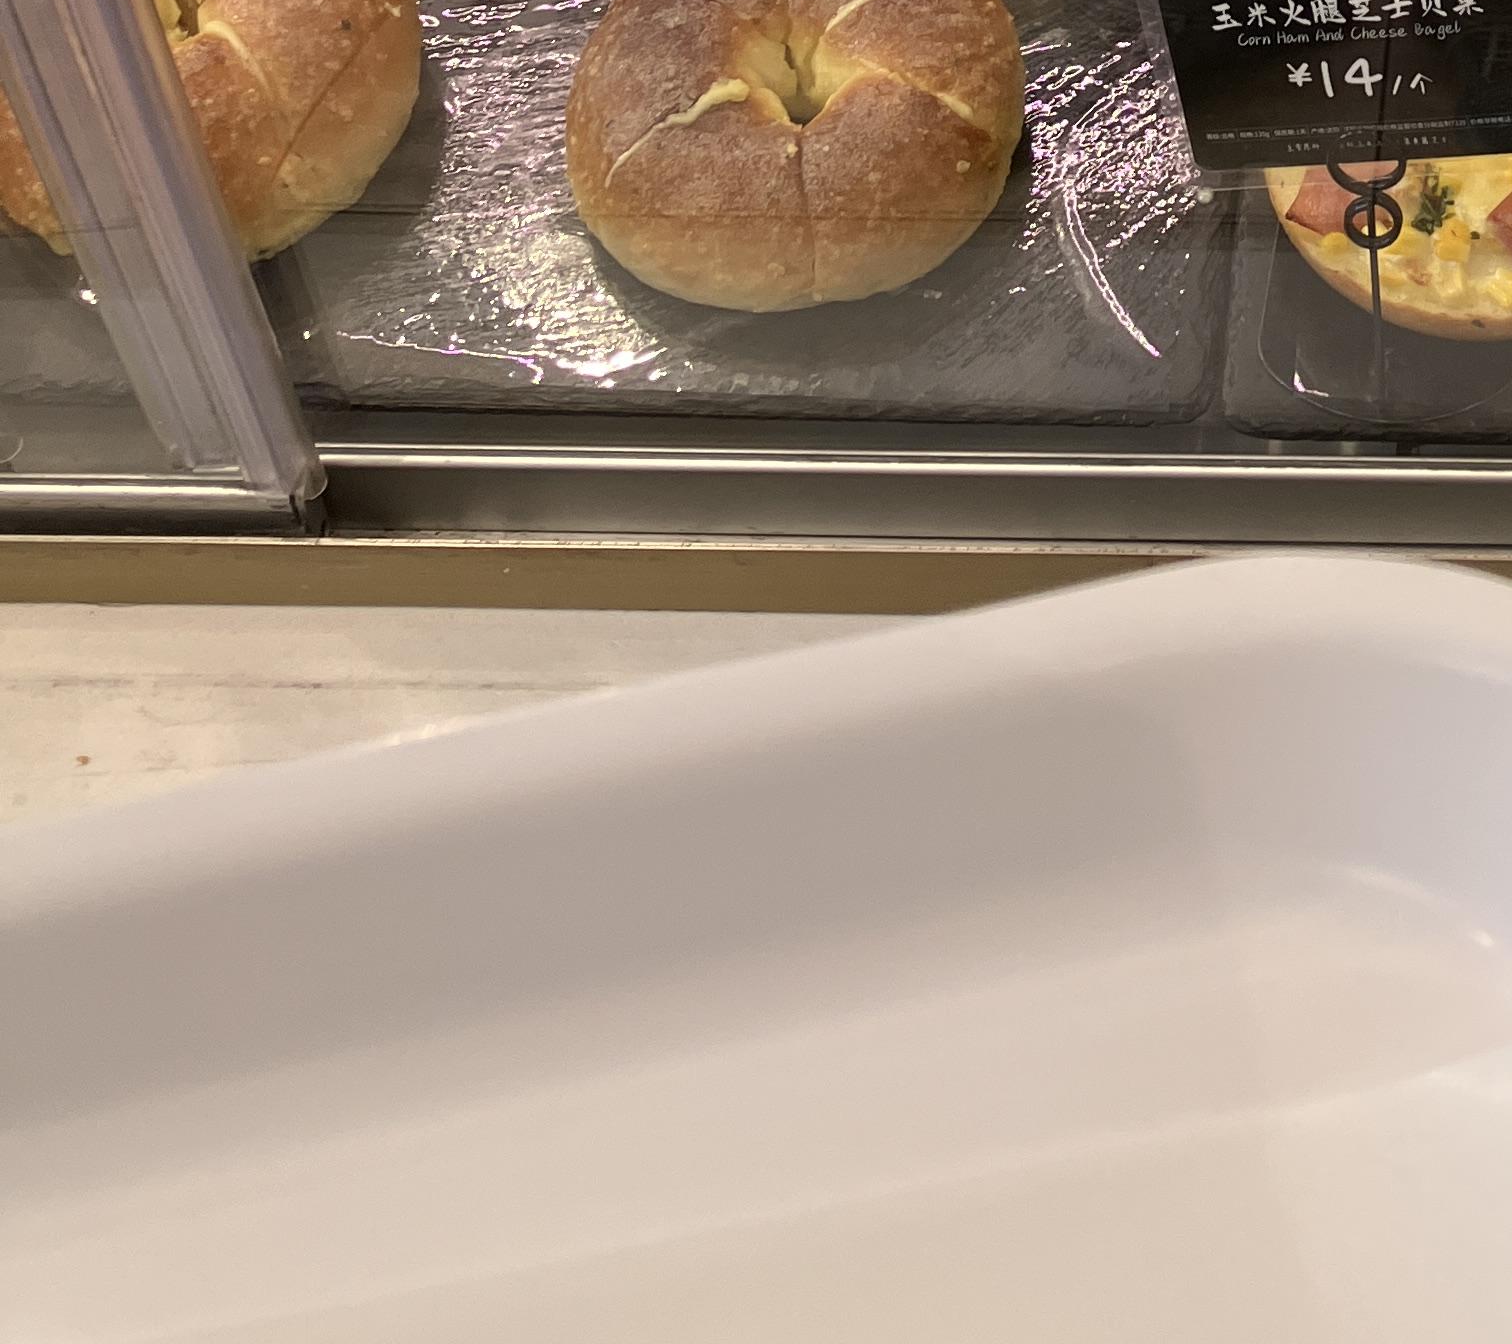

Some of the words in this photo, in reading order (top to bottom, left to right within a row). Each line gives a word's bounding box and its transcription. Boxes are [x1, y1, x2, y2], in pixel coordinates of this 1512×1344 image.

[1238, 32, 1271, 47] Corn
[1276, 29, 1310, 44] Ham
[1316, 26, 1344, 43] And
[1350, 23, 1408, 41] Cheese
[1414, 20, 1461, 41] Bagel
